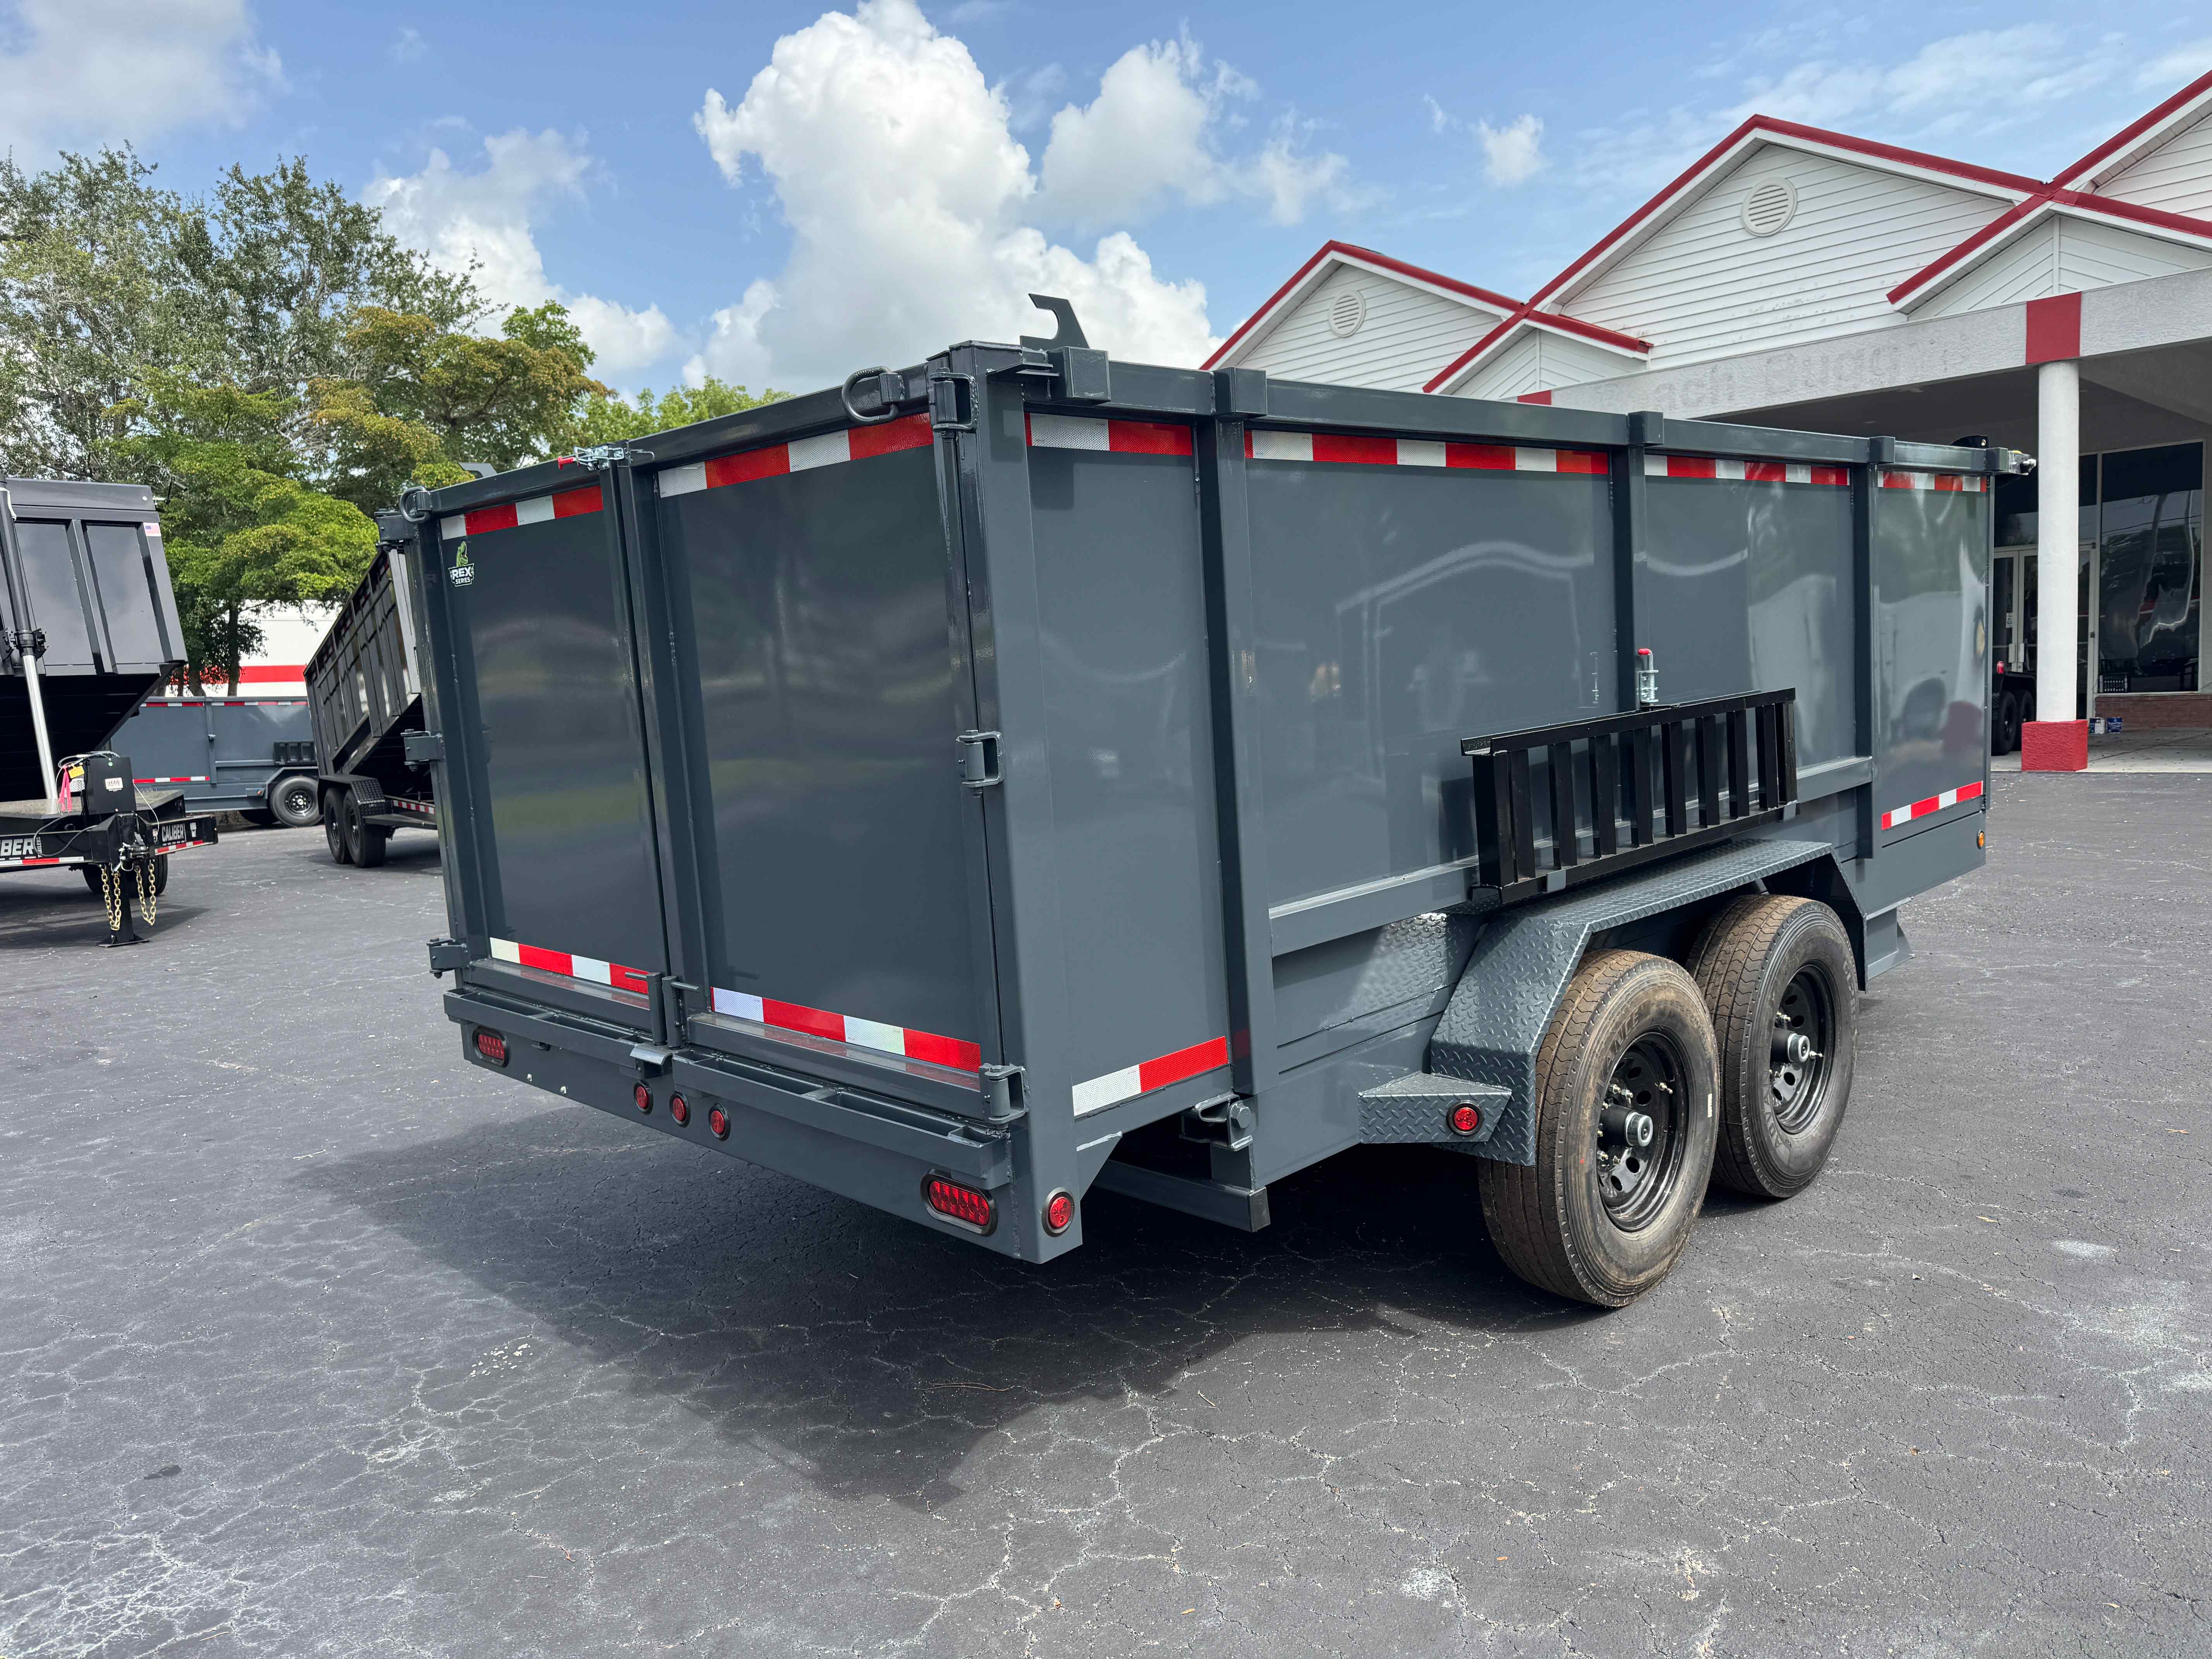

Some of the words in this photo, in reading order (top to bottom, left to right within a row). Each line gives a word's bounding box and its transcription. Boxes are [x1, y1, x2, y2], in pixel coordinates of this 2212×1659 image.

[452, 567, 472, 580] REX
[162, 824, 184, 842] CALIBER
[0, 838, 34, 856] BER
